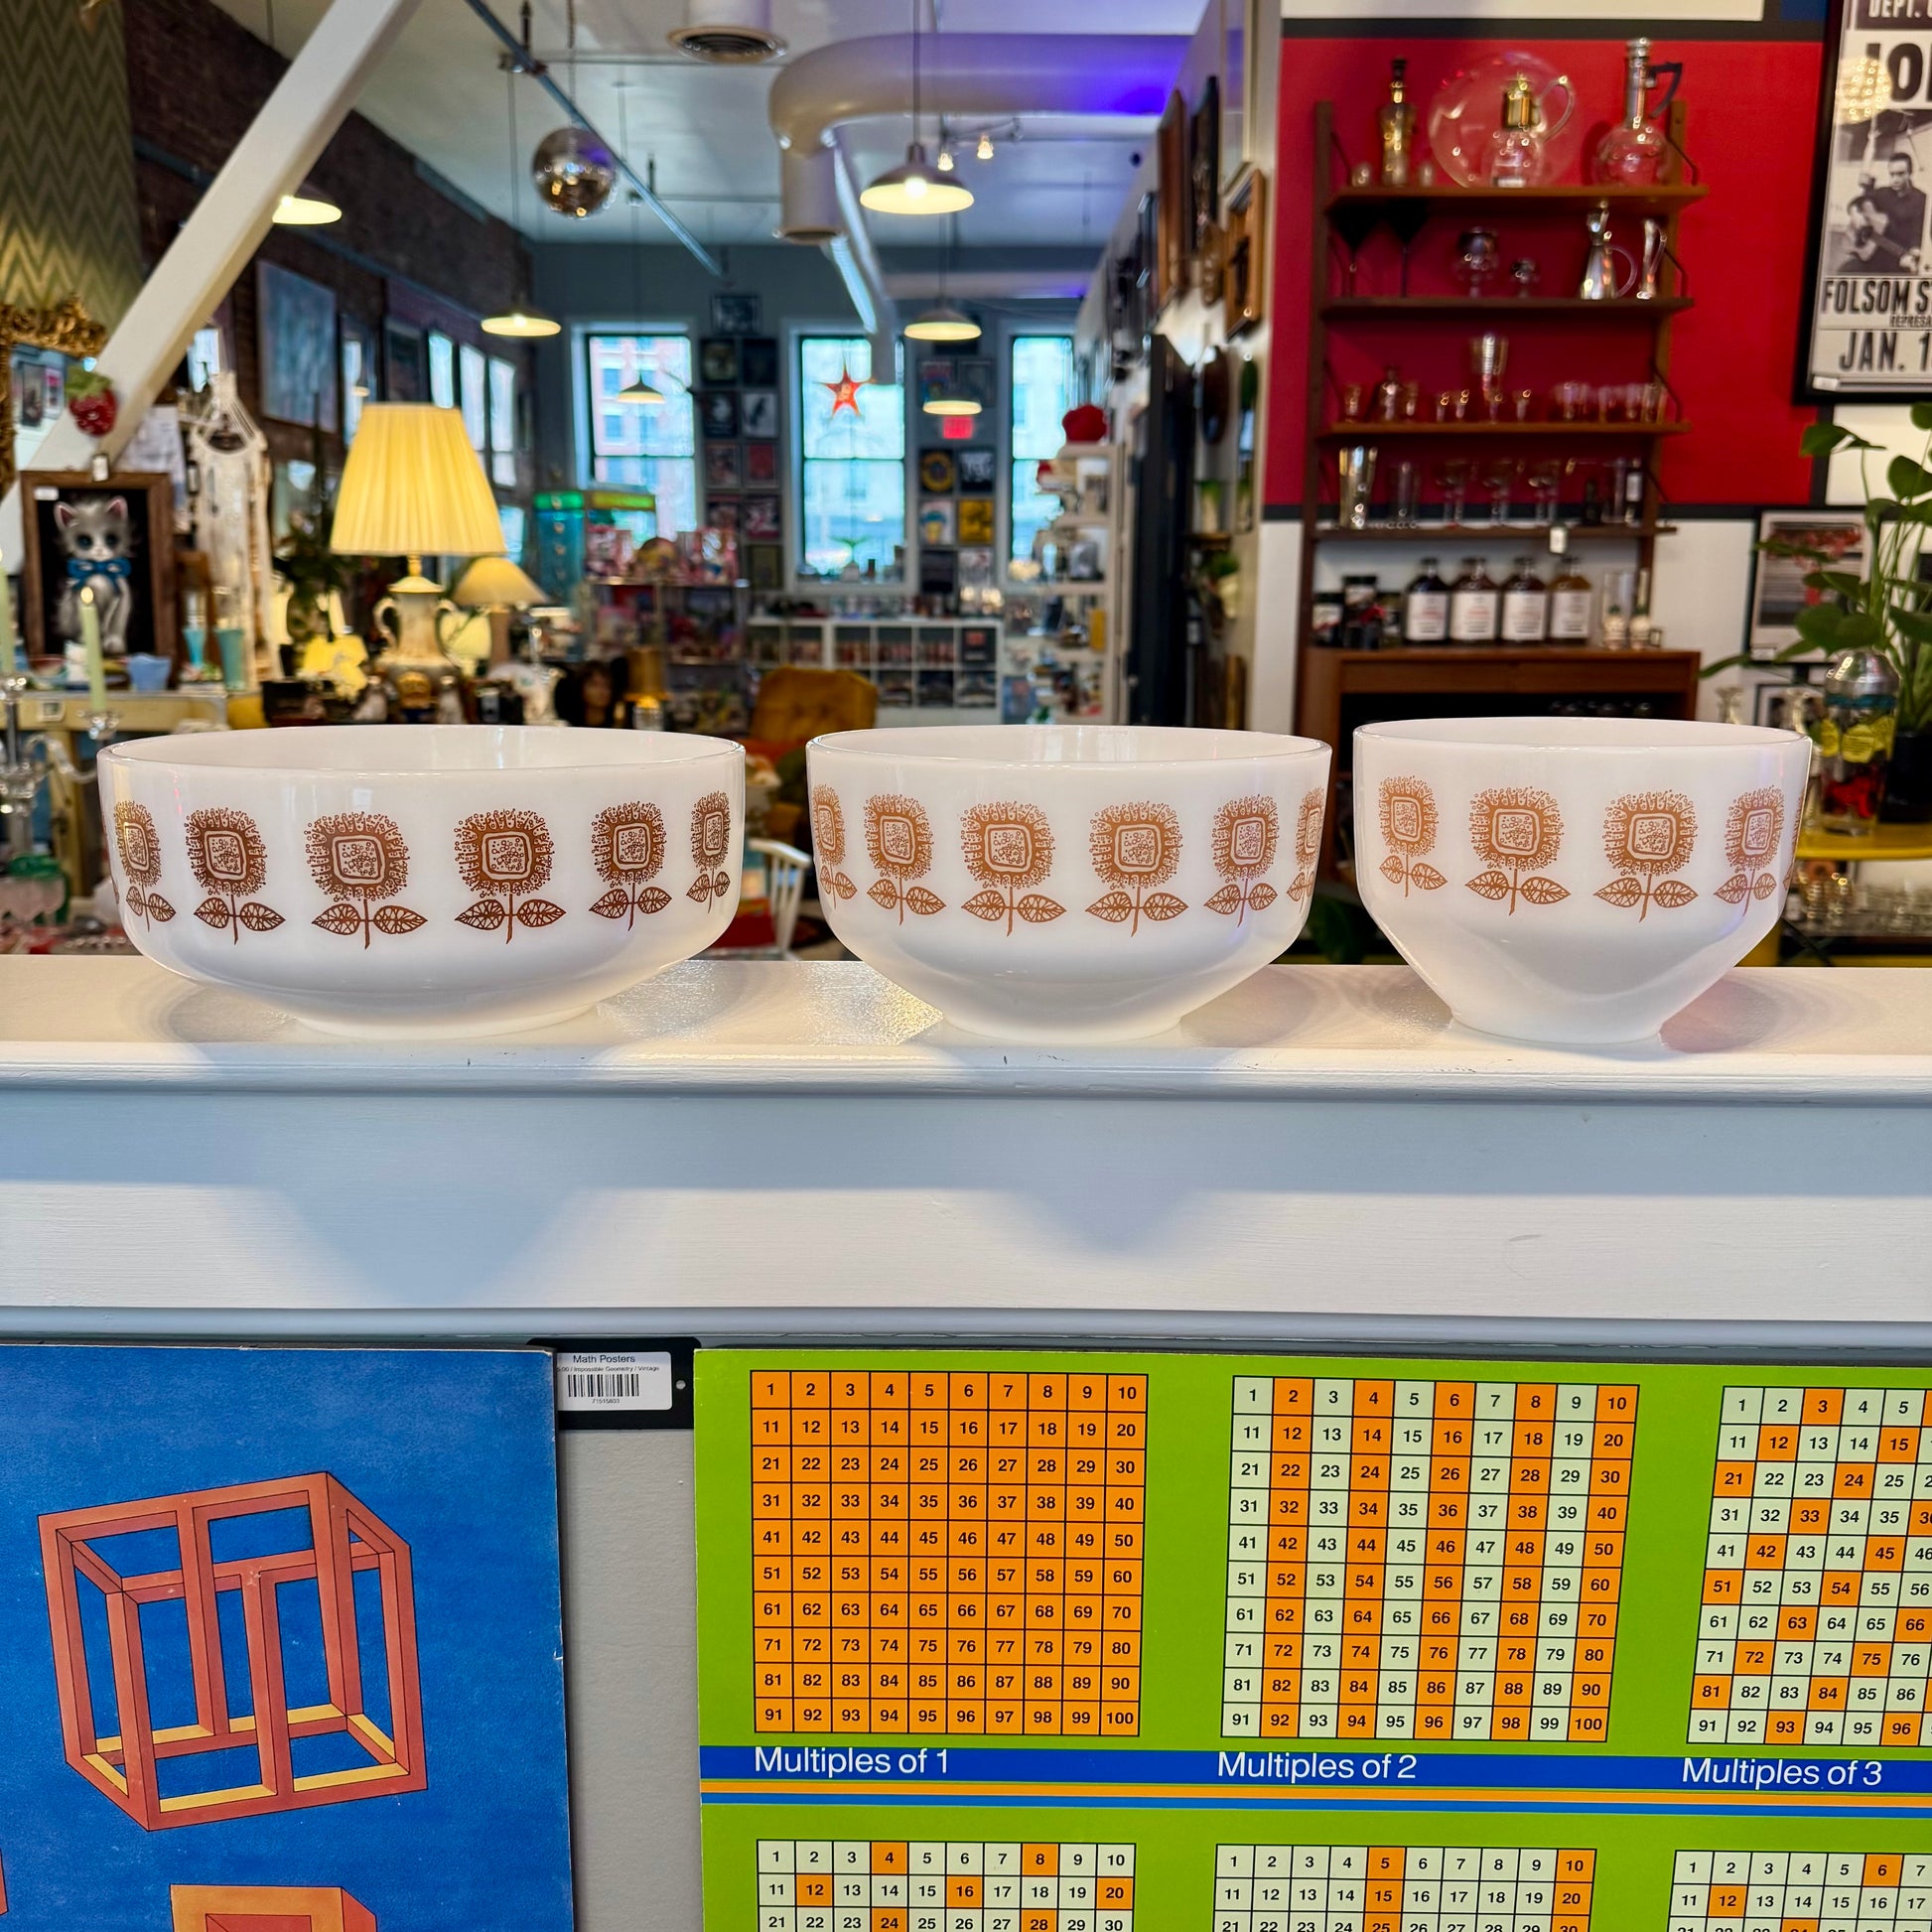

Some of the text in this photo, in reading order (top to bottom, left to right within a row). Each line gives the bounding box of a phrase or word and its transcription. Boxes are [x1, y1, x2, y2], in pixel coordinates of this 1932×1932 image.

[1821, 280, 1910, 315] FOLSOM
[1839, 332, 1905, 371] JAN.
[600, 1354, 635, 1363] Posters
[766, 1382, 1137, 1400] 1 2 3 4 5 6 7 8 9 10
[1249, 1388, 1627, 1411] 1 2 3 4 5 6 7 8 9 10
[1729, 1436, 1909, 1451] 11 12 13 14 15
[1241, 1462, 1620, 1484] 21 22 23 24 25 26 27 28 29 30
[762, 1530, 1134, 1548] 41 42 43 44 45 46 47 48 49 50
[1717, 1544, 1734, 1558] 41
[1755, 1545, 1776, 1558] 42
[1795, 1545, 1816, 1559] 43
[1835, 1546, 1856, 1559] 44
[1874, 1547, 1895, 1560] 45
[1237, 1572, 1610, 1591] 51 52 53 54 55 56 57 58 59 60
[1706, 1650, 1920, 1666] 71 72 73 74 75 76
[764, 1708, 1134, 1725] 91 92 93 94 95 96 97 98 99 100
[1232, 1713, 1602, 1730] 91 92 93 94 95 96 97 98 99 100
[1699, 1720, 1911, 1734] 91 92 93 94 95 96
[755, 1746, 947, 1778] Multiples of 1
[1218, 1751, 1417, 1784] Multiples of 2
[1682, 1757, 1882, 1791] Multiples of 3
[1230, 1856, 1584, 1872] 1 2 3 4 5 6 7 8 9 10
[768, 1883, 1125, 1899] 11 12 13 14 15 16 17 18 19 20
[1681, 1894, 1926, 1909] 11 12 13 14 15 16 17
